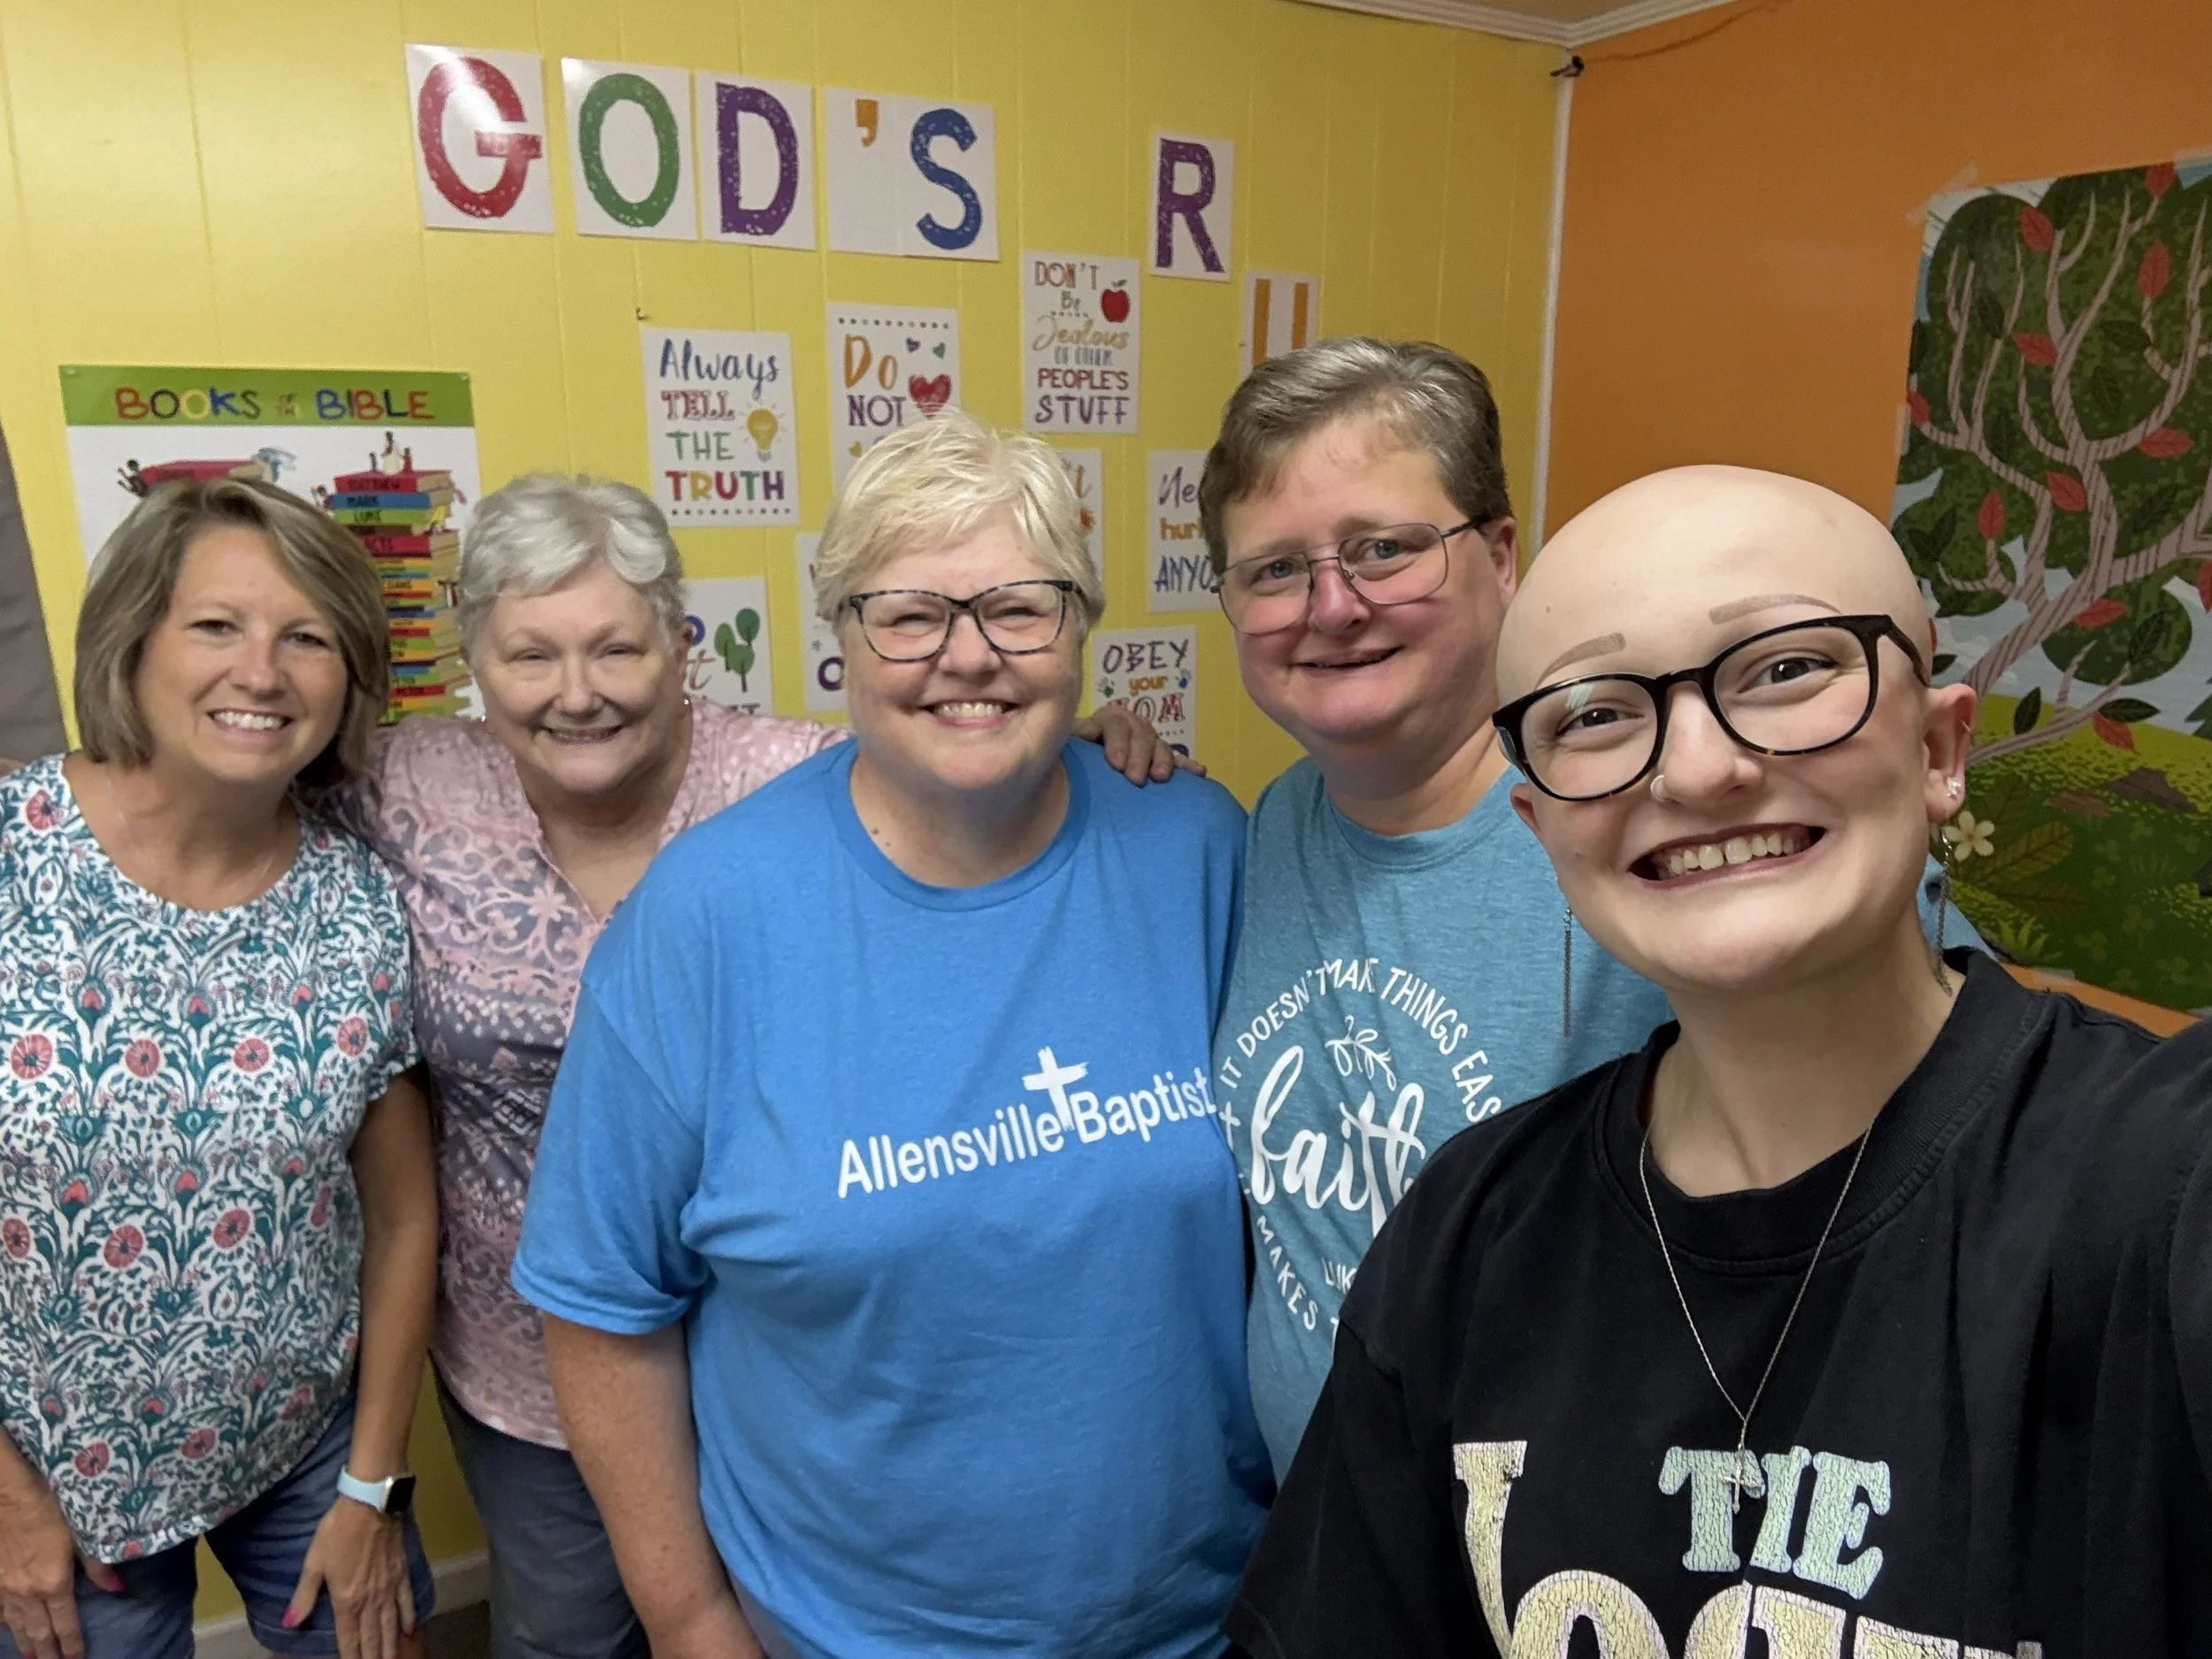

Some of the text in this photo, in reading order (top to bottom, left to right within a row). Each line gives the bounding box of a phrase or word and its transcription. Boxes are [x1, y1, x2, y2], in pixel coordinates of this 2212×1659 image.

[418, 57, 982, 250] GOD'S
[1033, 261, 1100, 290] DON'T
[1061, 292, 1081, 310] Be
[1032, 314, 1130, 351] Jealous
[659, 338, 780, 400] Always
[843, 334, 898, 390] Do
[1037, 368, 1130, 390] PEOPLE'S
[114, 386, 262, 421] BOOKS
[315, 388, 436, 421] BIBLE
[661, 389, 736, 421] TELL
[847, 395, 907, 426] NOT
[1034, 396, 1131, 426] STUFF
[666, 431, 735, 461] THE
[665, 470, 786, 502] TRUTH
[1154, 555, 1213, 594] ANYO
[1102, 638, 1189, 674] OBEY
[1128, 675, 1168, 696] your
[1219, 1056, 1242, 1089] IT
[1323, 957, 1379, 994] MAK
[1380, 966, 1469, 1056] THINGS
[1451, 1049, 1502, 1123] EAS
[838, 1102, 1064, 1200] Allensville
[1069, 1066, 1218, 1144] Baptist
[1256, 1214, 1319, 1332] MAKES
